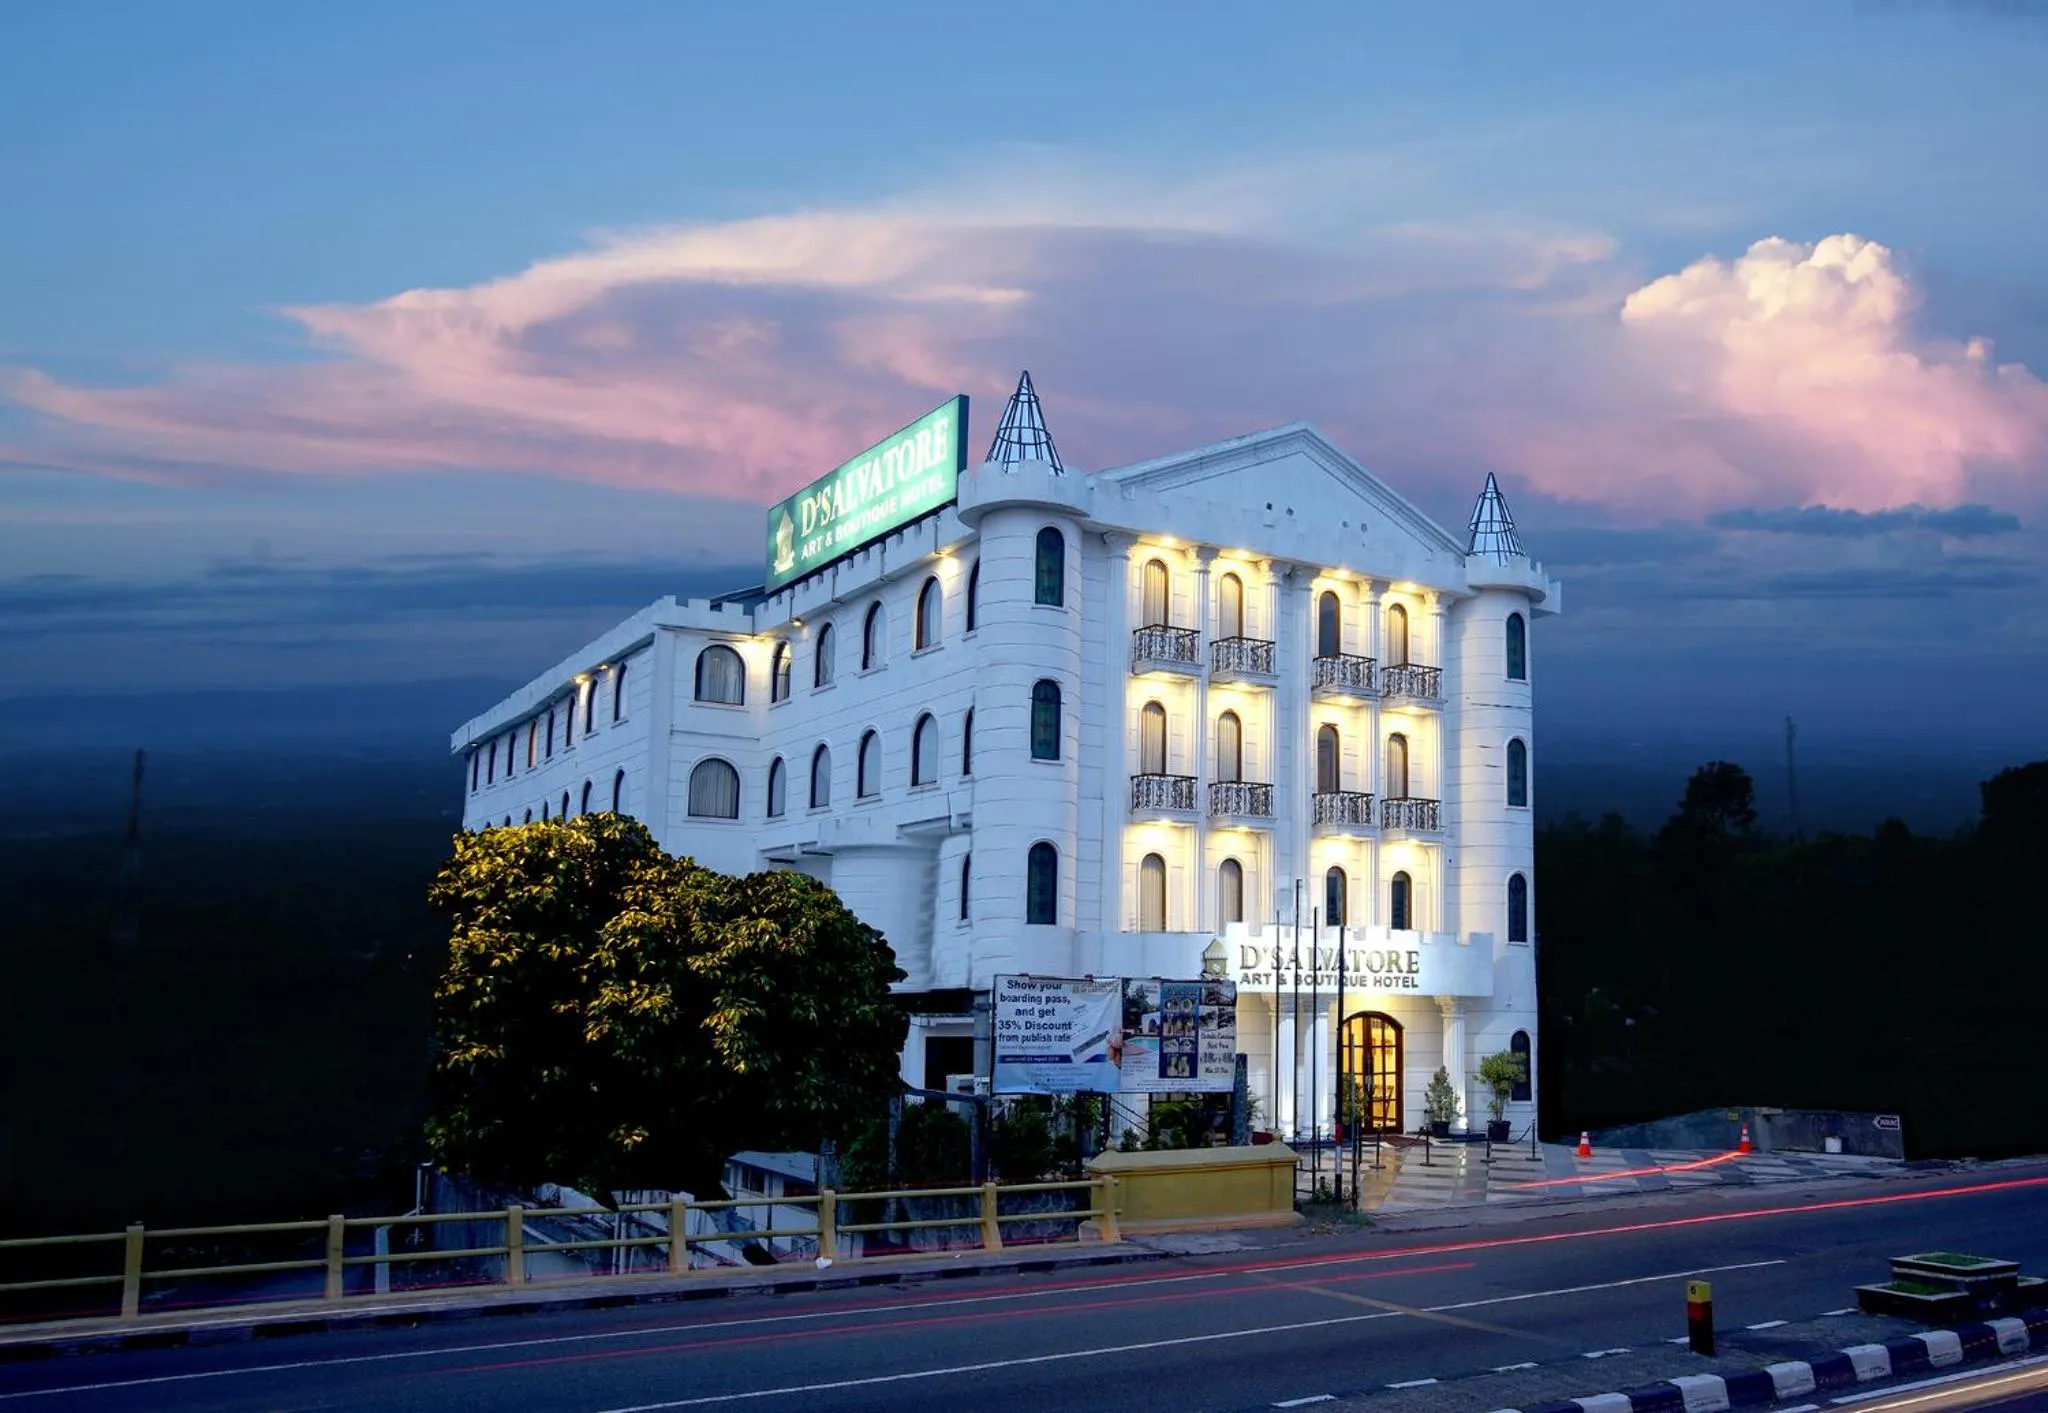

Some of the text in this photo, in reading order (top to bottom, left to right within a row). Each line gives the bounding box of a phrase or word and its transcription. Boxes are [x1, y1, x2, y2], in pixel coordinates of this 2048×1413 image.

[801, 417, 949, 537] D'SALVATORE
[801, 537, 821, 560] ART
[825, 533, 833, 546] &
[836, 497, 897, 541] BOUTIQUE
[1239, 945, 1420, 974] D'SALVATORE
[1007, 980, 1037, 990] Show
[1040, 983, 1062, 992] your
[1240, 972, 1419, 988] ART & BOUTIQUE HOTEL
[1000, 993, 1071, 1005] boarding pass,
[1015, 1007, 1055, 1018] and get
[998, 1020, 1022, 1030] 35%
[1024, 1020, 1072, 1030] Discount
[998, 1033, 1071, 1044] from publish rate
